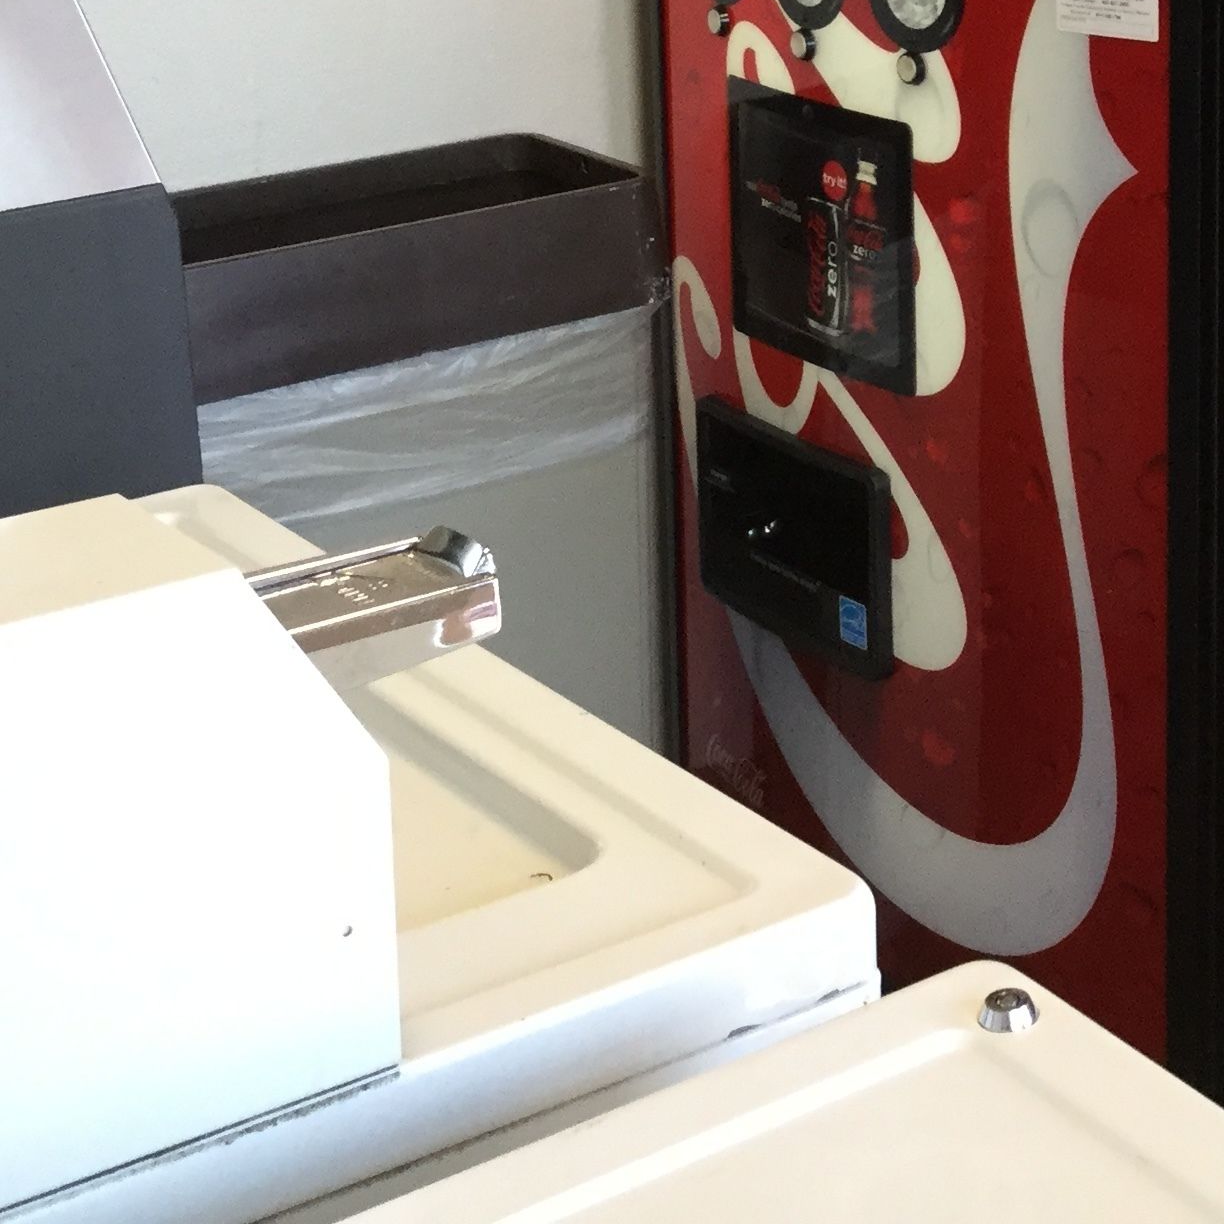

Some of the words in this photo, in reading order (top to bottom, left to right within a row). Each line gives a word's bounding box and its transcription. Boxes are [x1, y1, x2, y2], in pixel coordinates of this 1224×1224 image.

[822, 172, 836, 187] try
[853, 244, 878, 260] zero
[827, 241, 838, 298] zero
